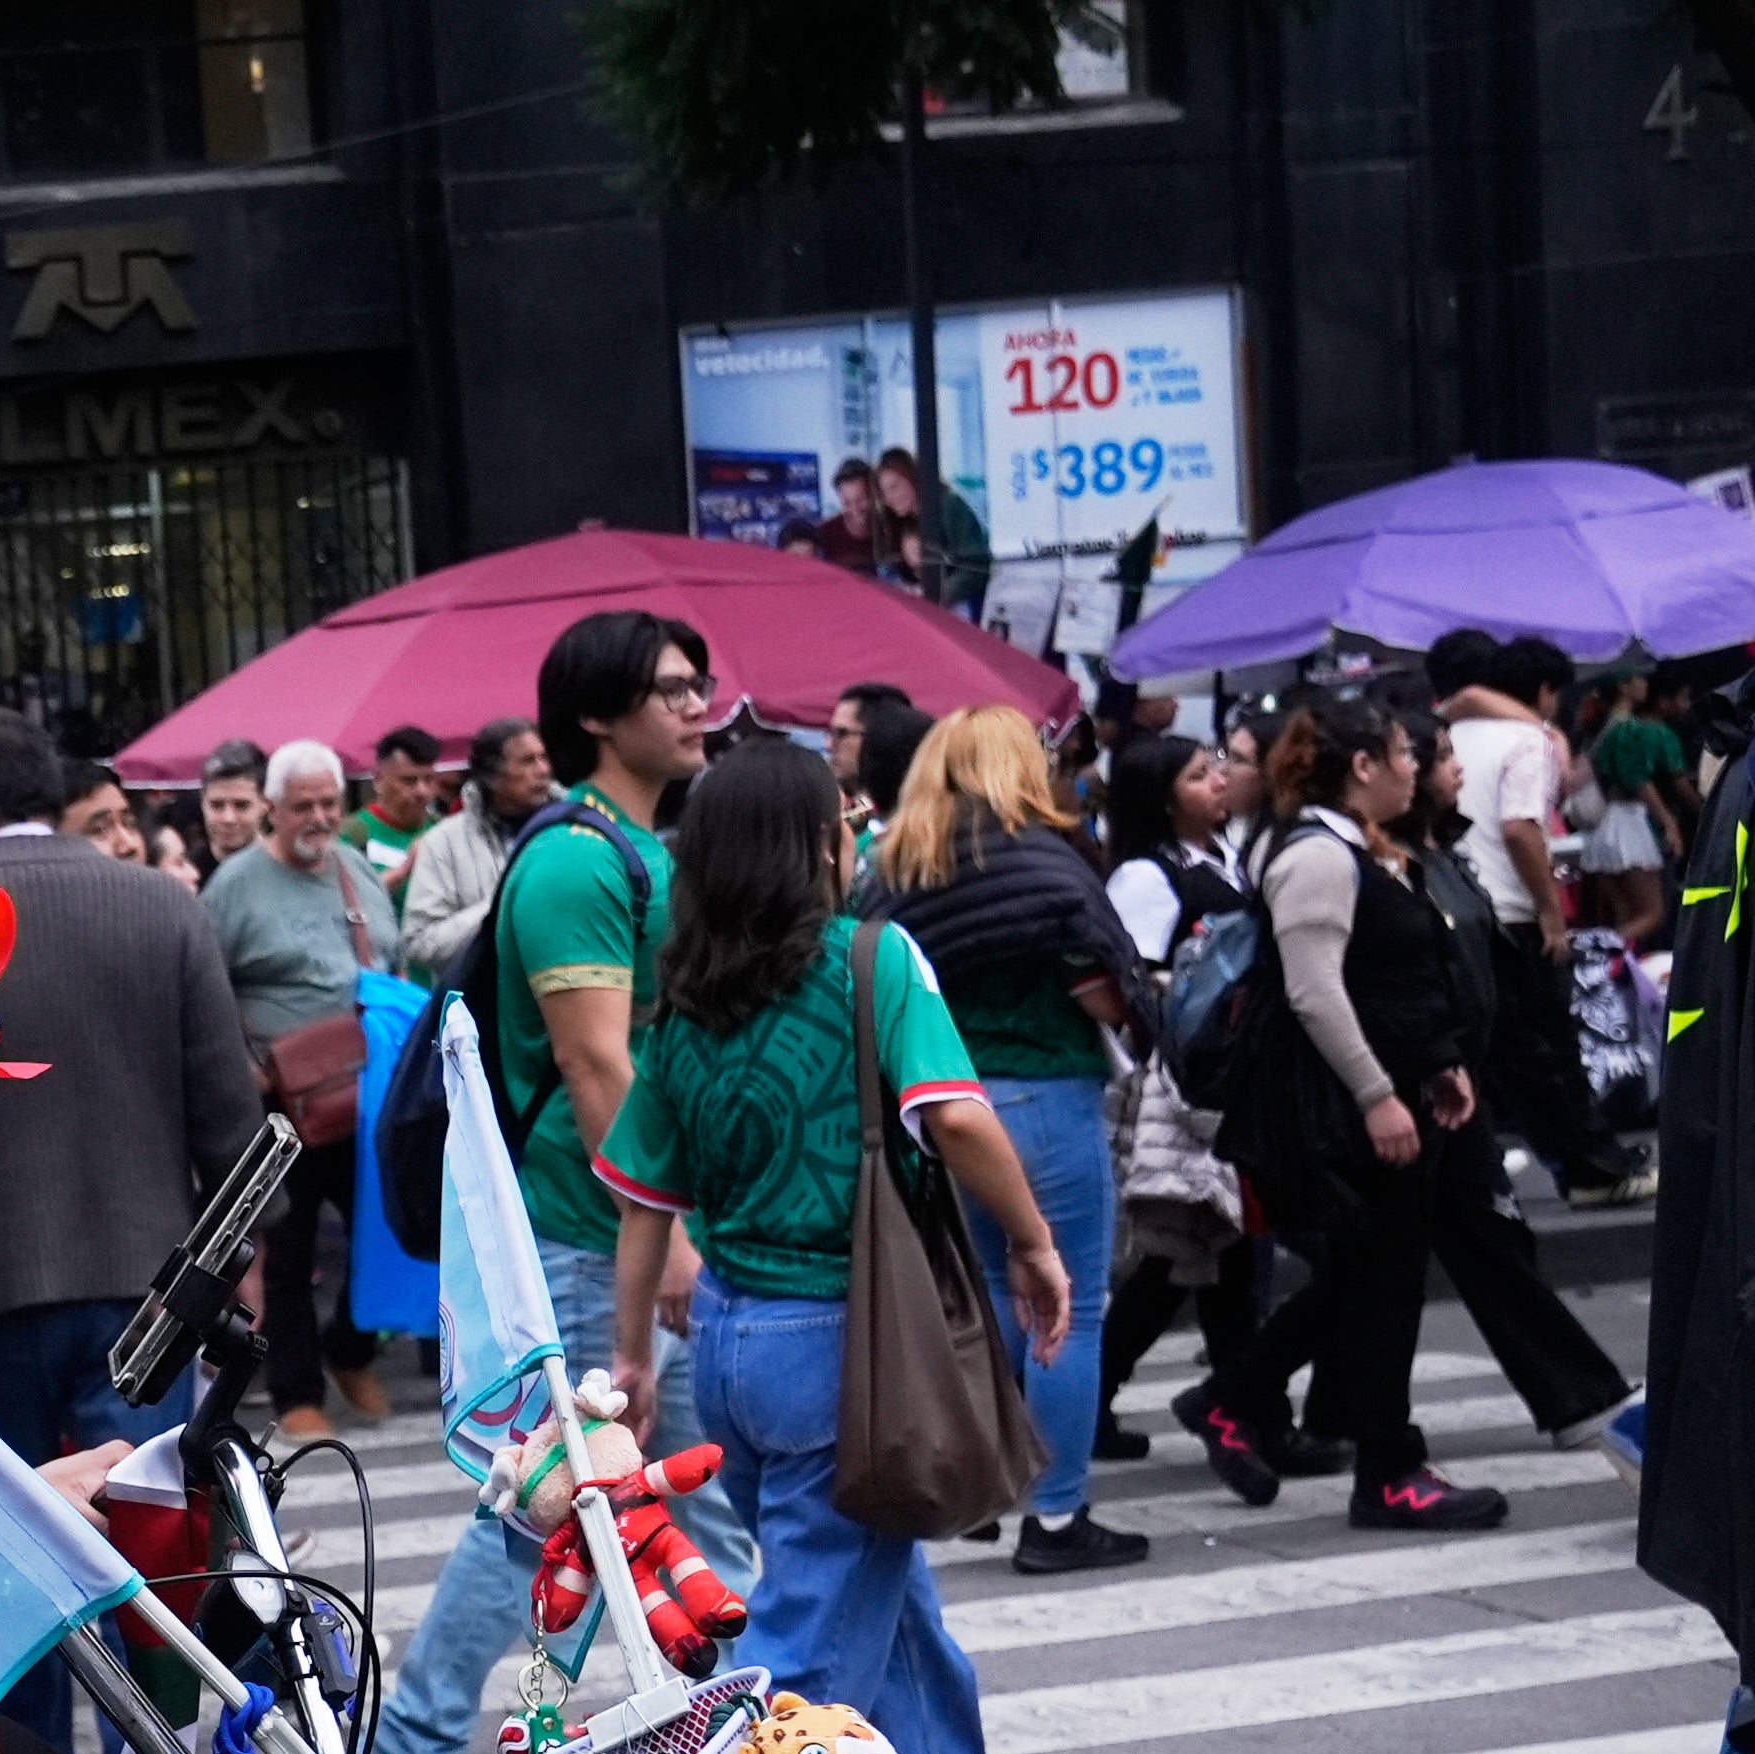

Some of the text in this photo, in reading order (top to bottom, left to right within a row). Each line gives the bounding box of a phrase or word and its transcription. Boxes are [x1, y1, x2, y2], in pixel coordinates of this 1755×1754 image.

[1643, 64, 1698, 160] 4
[1005, 329, 1076, 351] AHORA
[1005, 352, 1120, 416] 120
[1032, 437, 1164, 498] $389
